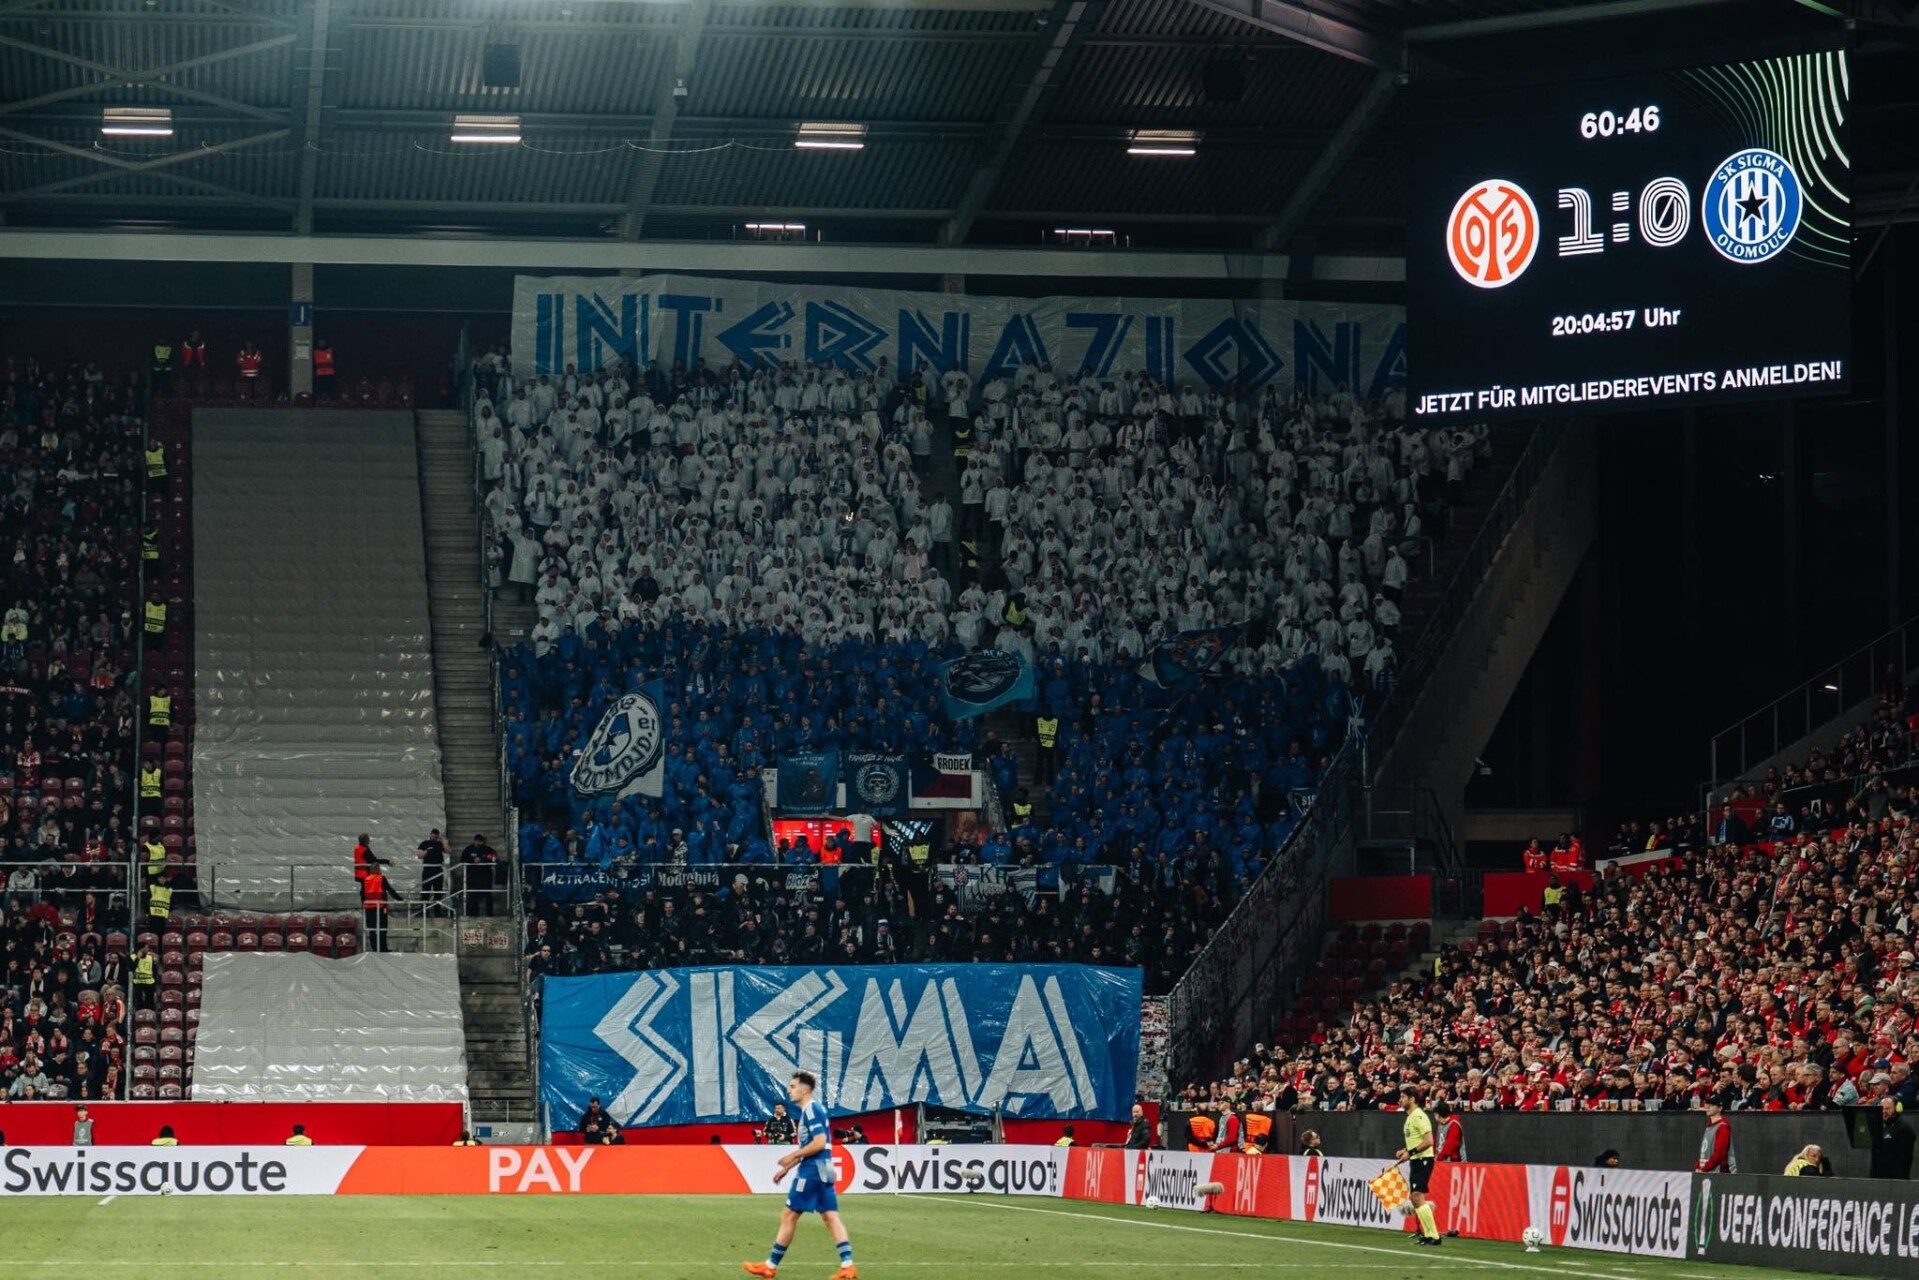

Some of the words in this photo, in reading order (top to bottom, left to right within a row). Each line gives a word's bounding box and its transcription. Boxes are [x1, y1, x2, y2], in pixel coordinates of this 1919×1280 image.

[1581, 106, 1660, 139] 60:46
[1718, 162, 1738, 184] SK
[1737, 154, 1785, 178] SIGMA
[1558, 177, 1691, 257] 1:0
[1717, 227, 1789, 258] OLOMOUC
[1552, 309, 1636, 336] 20:04:57
[1644, 307, 1682, 328] Uhr
[1415, 391, 1474, 416] JETZT
[1478, 385, 1517, 410] FÜR
[1521, 371, 1717, 406] MITGLIEDEREVENTS
[1720, 360, 1842, 390] ANMELDEN!
[937, 757, 970, 771] BRODEK
[592, 969, 1098, 1126] SIGMA
[4, 1148, 287, 1194] Swissquote
[489, 1148, 596, 1192] PAY
[862, 1146, 1057, 1194] Swissquote
[1084, 1151, 1104, 1198] PAY
[1145, 1152, 1198, 1209] Swissquote
[1234, 1157, 1262, 1212] PAY
[1448, 1165, 1487, 1233] PAY
[1570, 1170, 1682, 1255] Swissquote
[1719, 1193, 1763, 1245] UEFA
[1768, 1194, 1894, 1256] CONFERENCE
